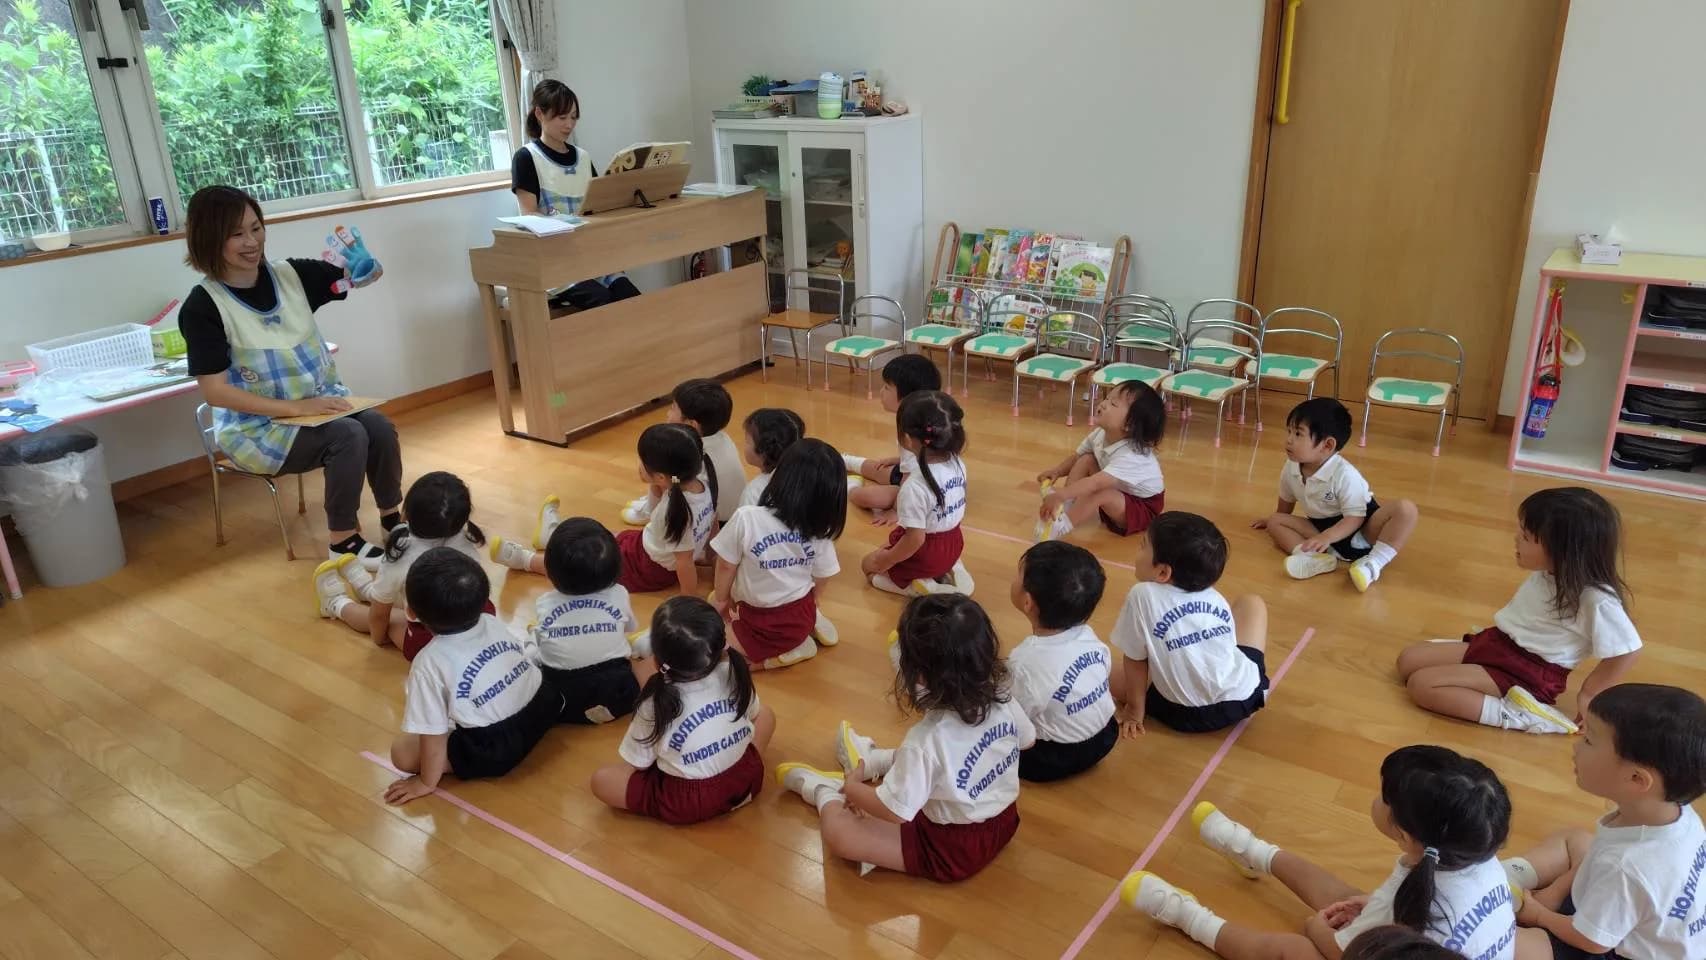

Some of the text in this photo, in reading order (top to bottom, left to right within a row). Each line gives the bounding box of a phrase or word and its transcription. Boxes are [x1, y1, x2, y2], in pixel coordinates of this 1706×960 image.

[759, 559, 788, 569] KINDER
[548, 622, 618, 640] KINDER GARTEN
[1165, 631, 1202, 652] KINDER
[472, 679, 506, 709] KINDER
[1065, 690, 1098, 715] KINDER
[681, 741, 720, 766] KINDER
[968, 768, 997, 801] KINDER
